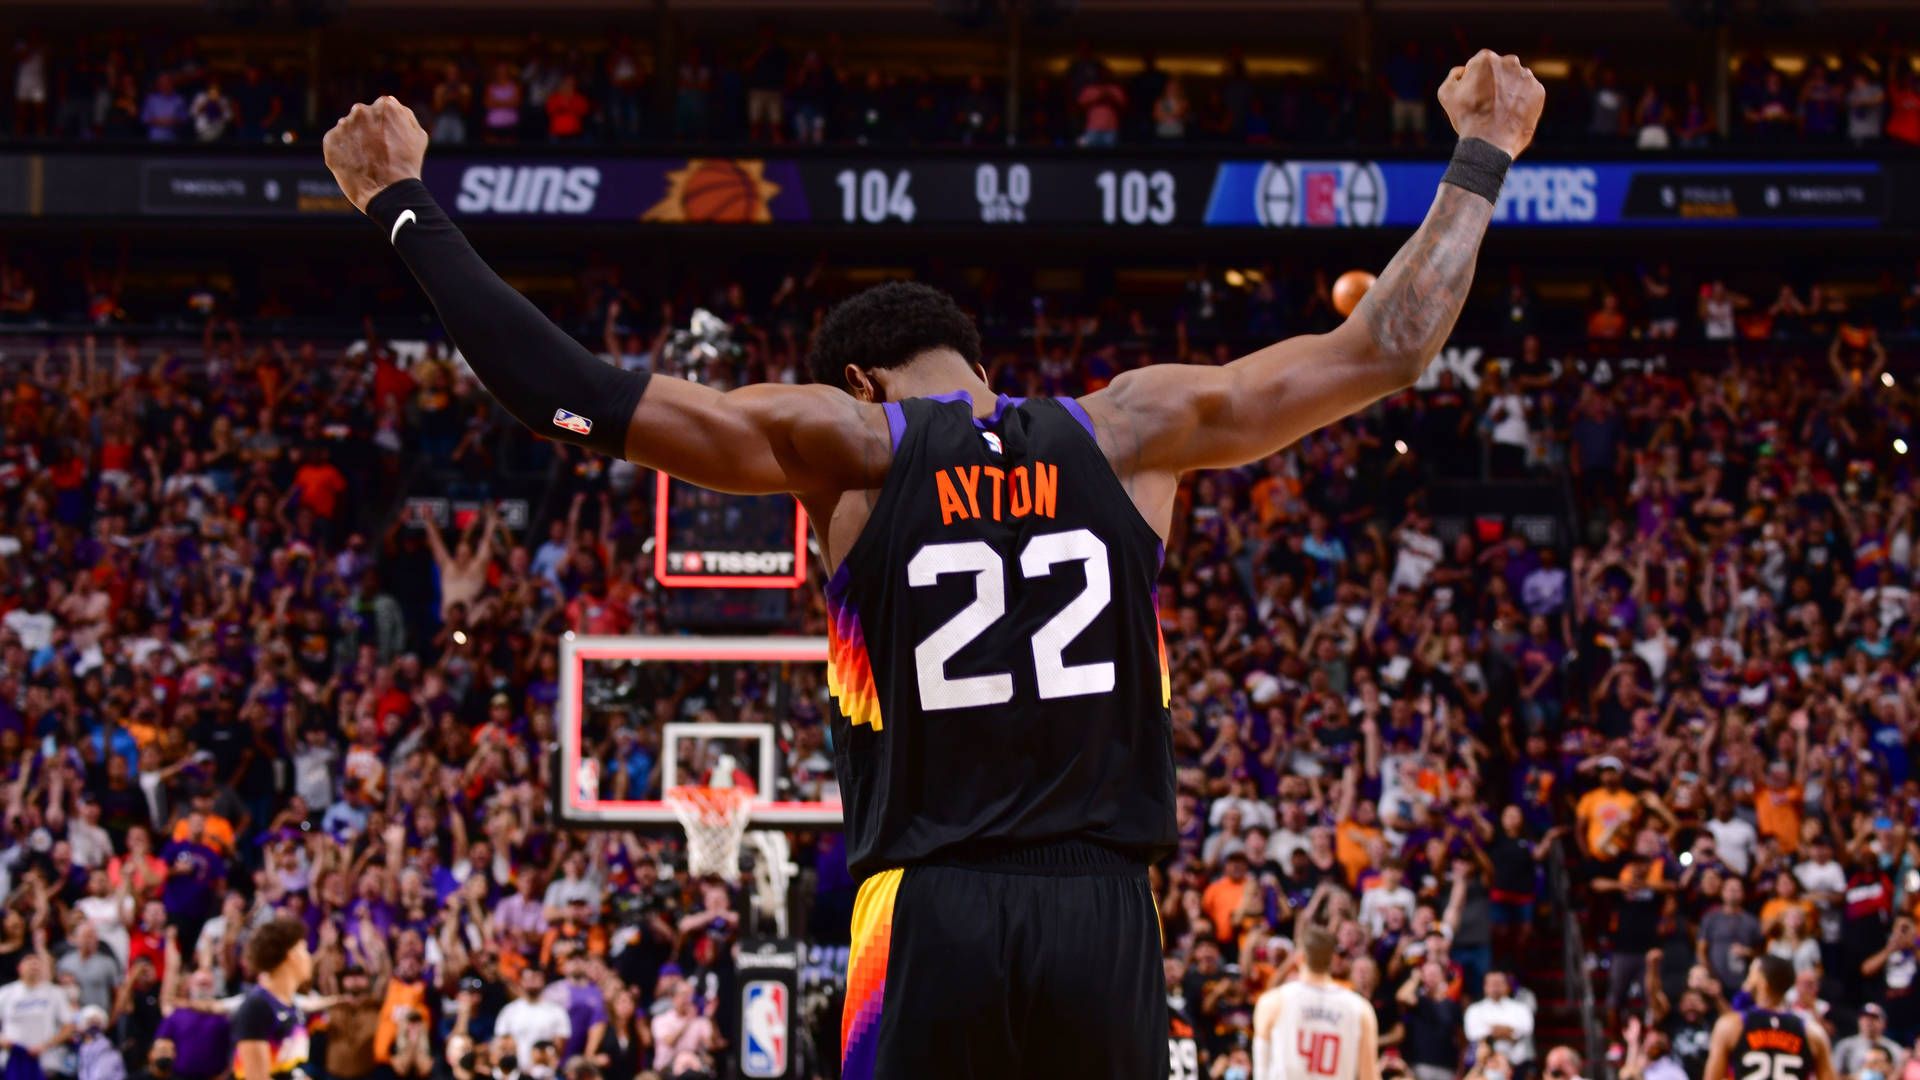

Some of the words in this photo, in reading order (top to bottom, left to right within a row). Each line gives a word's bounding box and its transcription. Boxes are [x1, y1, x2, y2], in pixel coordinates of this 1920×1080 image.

[456, 166, 600, 212] SUNS
[836, 169, 915, 222] 104
[1097, 171, 1176, 224] 103
[935, 461, 1058, 525] AYTON
[703, 551, 794, 573] TISSOT
[907, 528, 1116, 711] 22
[1297, 1030, 1342, 1077] 40
[1741, 1051, 1804, 1080] 25
